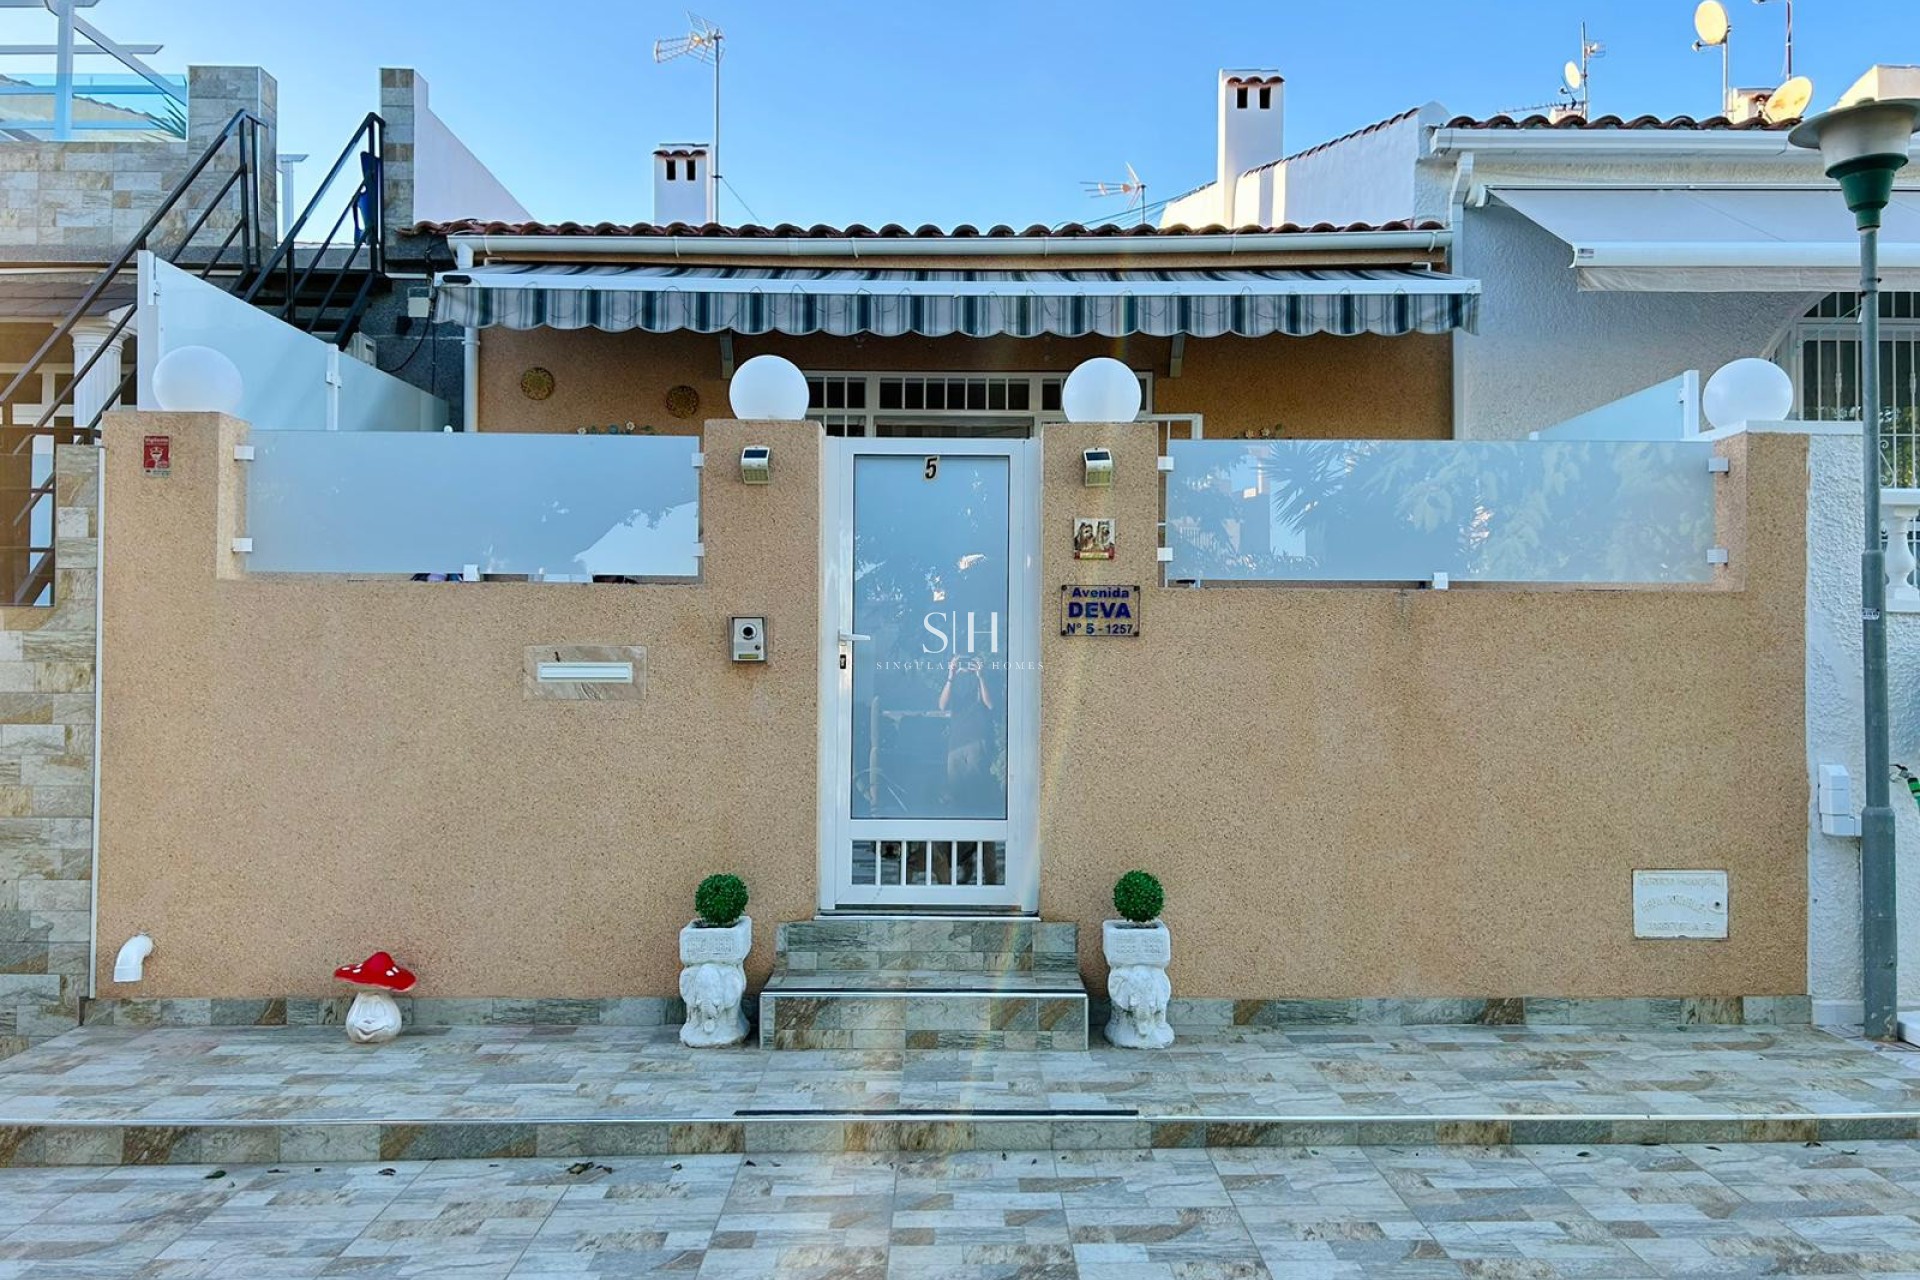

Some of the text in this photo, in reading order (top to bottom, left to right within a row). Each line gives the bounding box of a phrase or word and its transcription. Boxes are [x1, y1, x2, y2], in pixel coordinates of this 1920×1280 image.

[925, 457, 938, 479] 5
[1072, 587, 1130, 598] Avenida
[1068, 602, 1131, 619] DEVA
[1086, 623, 1095, 634] 5
[1105, 624, 1134, 634] 1257
